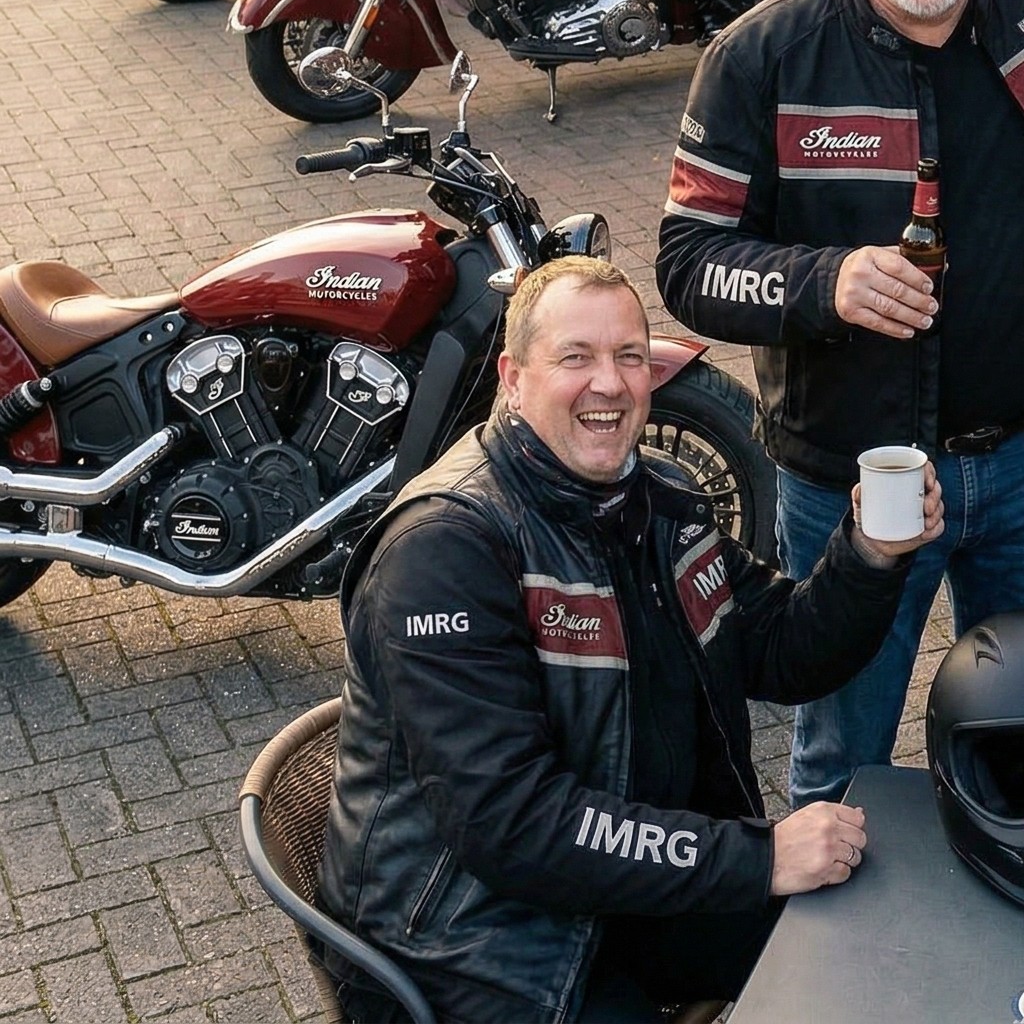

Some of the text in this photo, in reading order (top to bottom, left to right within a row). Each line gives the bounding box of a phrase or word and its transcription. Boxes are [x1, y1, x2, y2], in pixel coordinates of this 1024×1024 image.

[800, 126, 881, 149] Indian
[305, 265, 382, 290] Indian
[701, 262, 785, 306] IMRG
[693, 555, 728, 600] IMR
[406, 612, 469, 637] IMRG
[575, 807, 698, 868] IMRG
